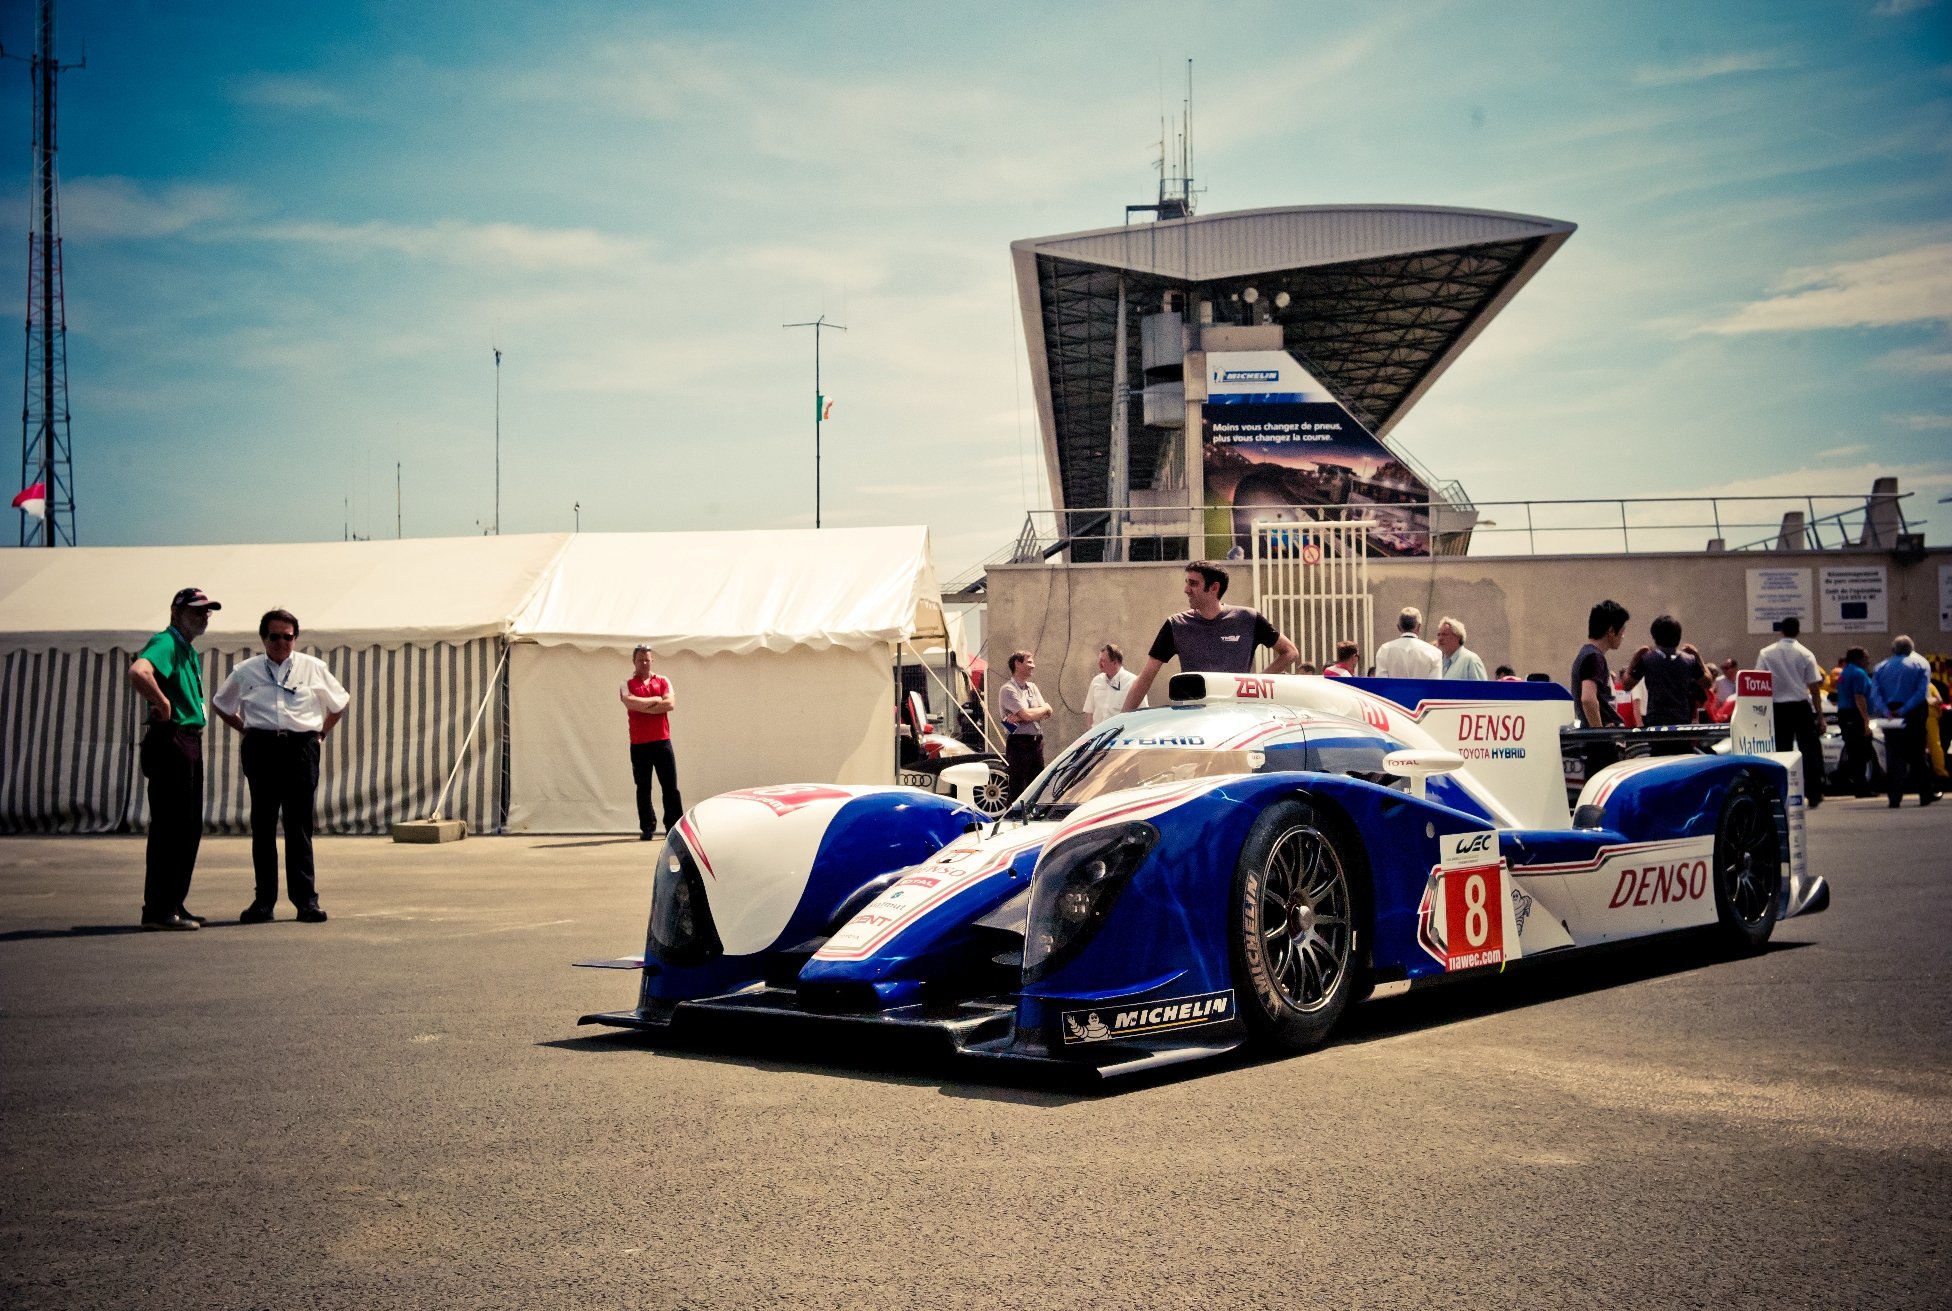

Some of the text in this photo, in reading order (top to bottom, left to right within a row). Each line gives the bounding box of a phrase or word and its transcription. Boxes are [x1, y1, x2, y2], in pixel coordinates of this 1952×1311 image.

[1213, 423, 1239, 432] Moins
[1263, 422, 1299, 433] changez
[1301, 421, 1312, 431] de
[1213, 434, 1231, 443] plus
[1255, 433, 1291, 443] changez
[1293, 433, 1300, 441] la
[1234, 676, 1275, 699] ZENT
[1745, 676, 1772, 691] TOTAL
[1458, 714, 1526, 742] DENSO
[1386, 759, 1420, 767] TOTAL
[1459, 747, 1526, 759] TOYOTA HYBRID
[1455, 834, 1492, 854] WEC
[1608, 860, 1708, 909] DENSO
[1464, 874, 1489, 947] 8
[1114, 997, 1228, 1029] MICHELIN
